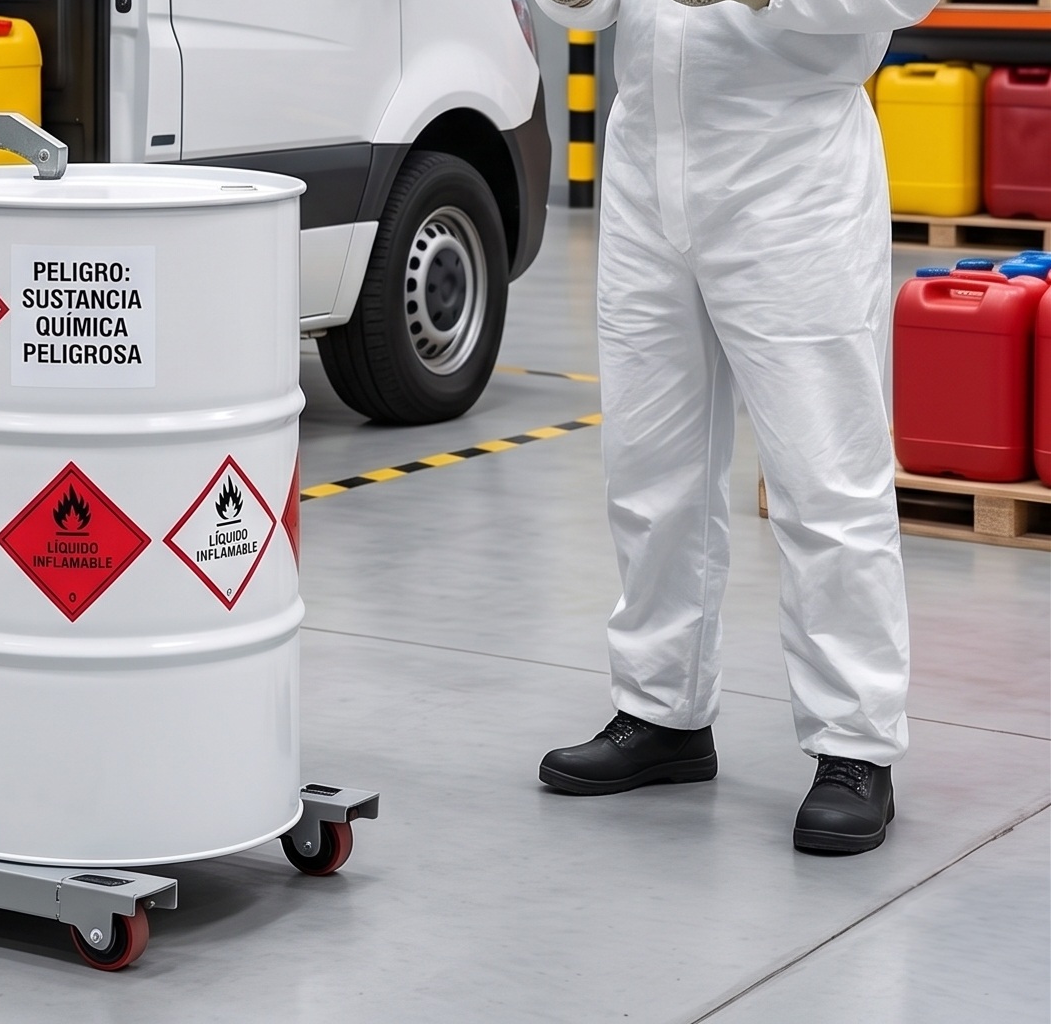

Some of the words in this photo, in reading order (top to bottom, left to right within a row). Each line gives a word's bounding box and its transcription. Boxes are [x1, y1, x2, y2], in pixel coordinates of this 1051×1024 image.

[34, 262, 130, 282] PELIGRO:
[22, 288, 142, 309] SUSTANCIA
[36, 312, 128, 337] QUÍMICA
[24, 343, 142, 364] PELIGROSA
[48, 540, 99, 554] LÍQUIDO
[209, 529, 248, 546] LÍQUIDO
[197, 541, 258, 562] INFLAMABLE
[33, 556, 113, 568] INFLAMABLE
